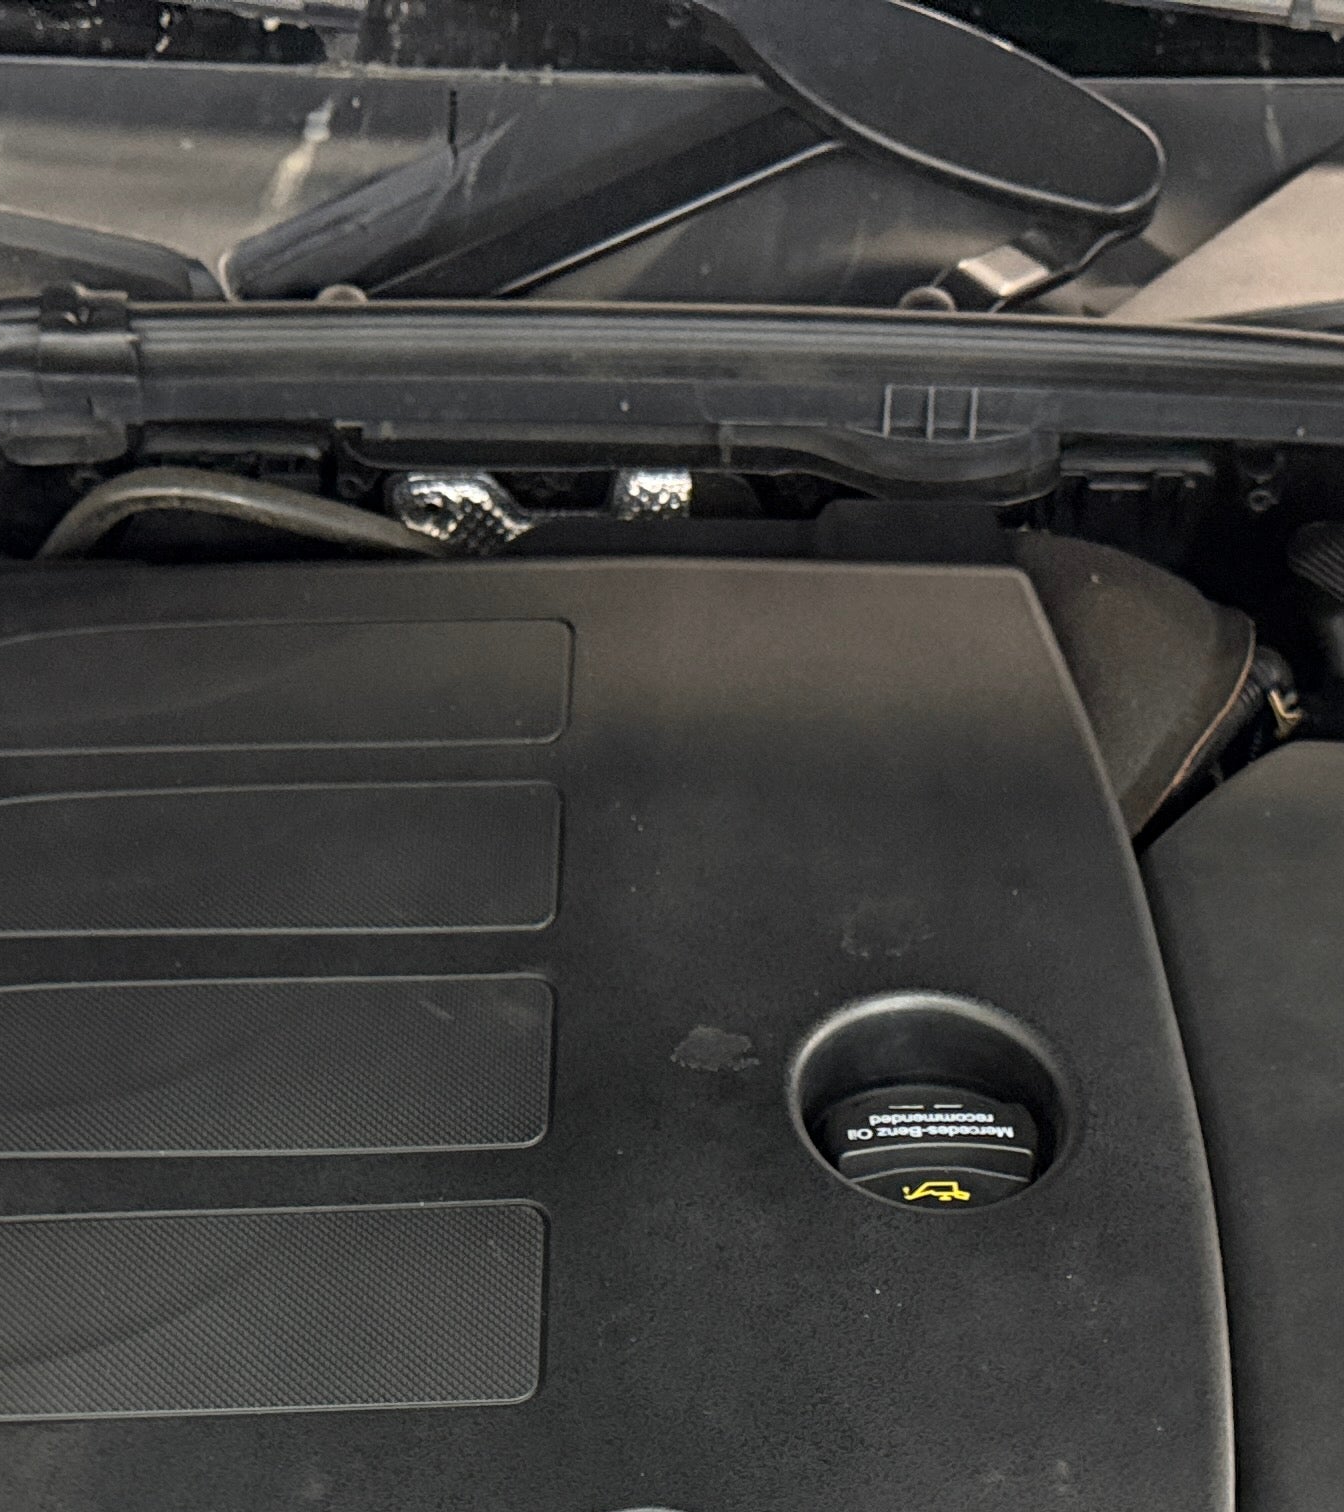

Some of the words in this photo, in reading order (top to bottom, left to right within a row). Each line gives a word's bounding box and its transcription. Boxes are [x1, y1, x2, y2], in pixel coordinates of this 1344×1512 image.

[869, 1113, 994, 1126] recommended
[846, 1128, 874, 1141] Oil
[877, 1126, 1015, 1139] Mercedes-Benz
